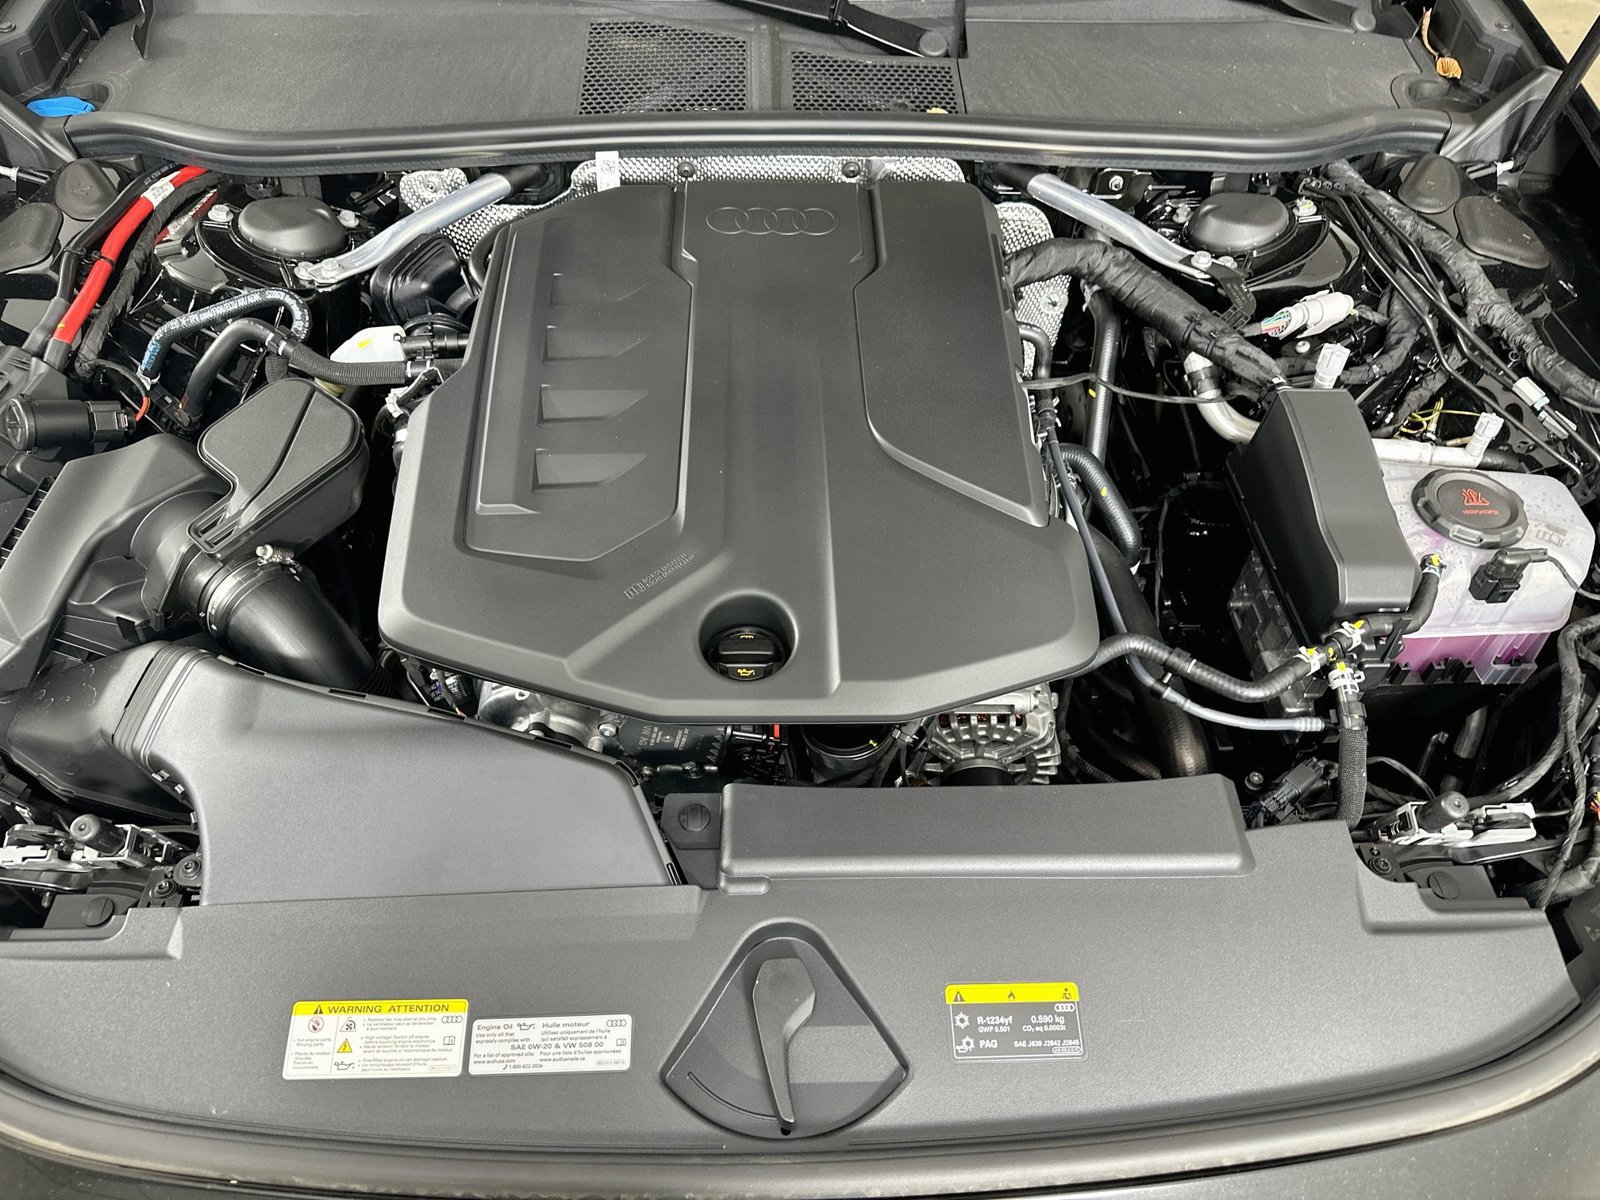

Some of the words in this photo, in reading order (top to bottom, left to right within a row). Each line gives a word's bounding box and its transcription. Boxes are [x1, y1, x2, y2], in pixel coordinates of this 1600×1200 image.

[328, 1005, 382, 1013] WARNING
[388, 1004, 450, 1013] ATTENTION
[977, 1016, 1013, 1025] R-1234yf
[1031, 1015, 1053, 1024] 0.590
[1055, 1014, 1065, 1025] kg
[477, 1023, 501, 1031] Engine
[979, 1039, 998, 1048] PAG
